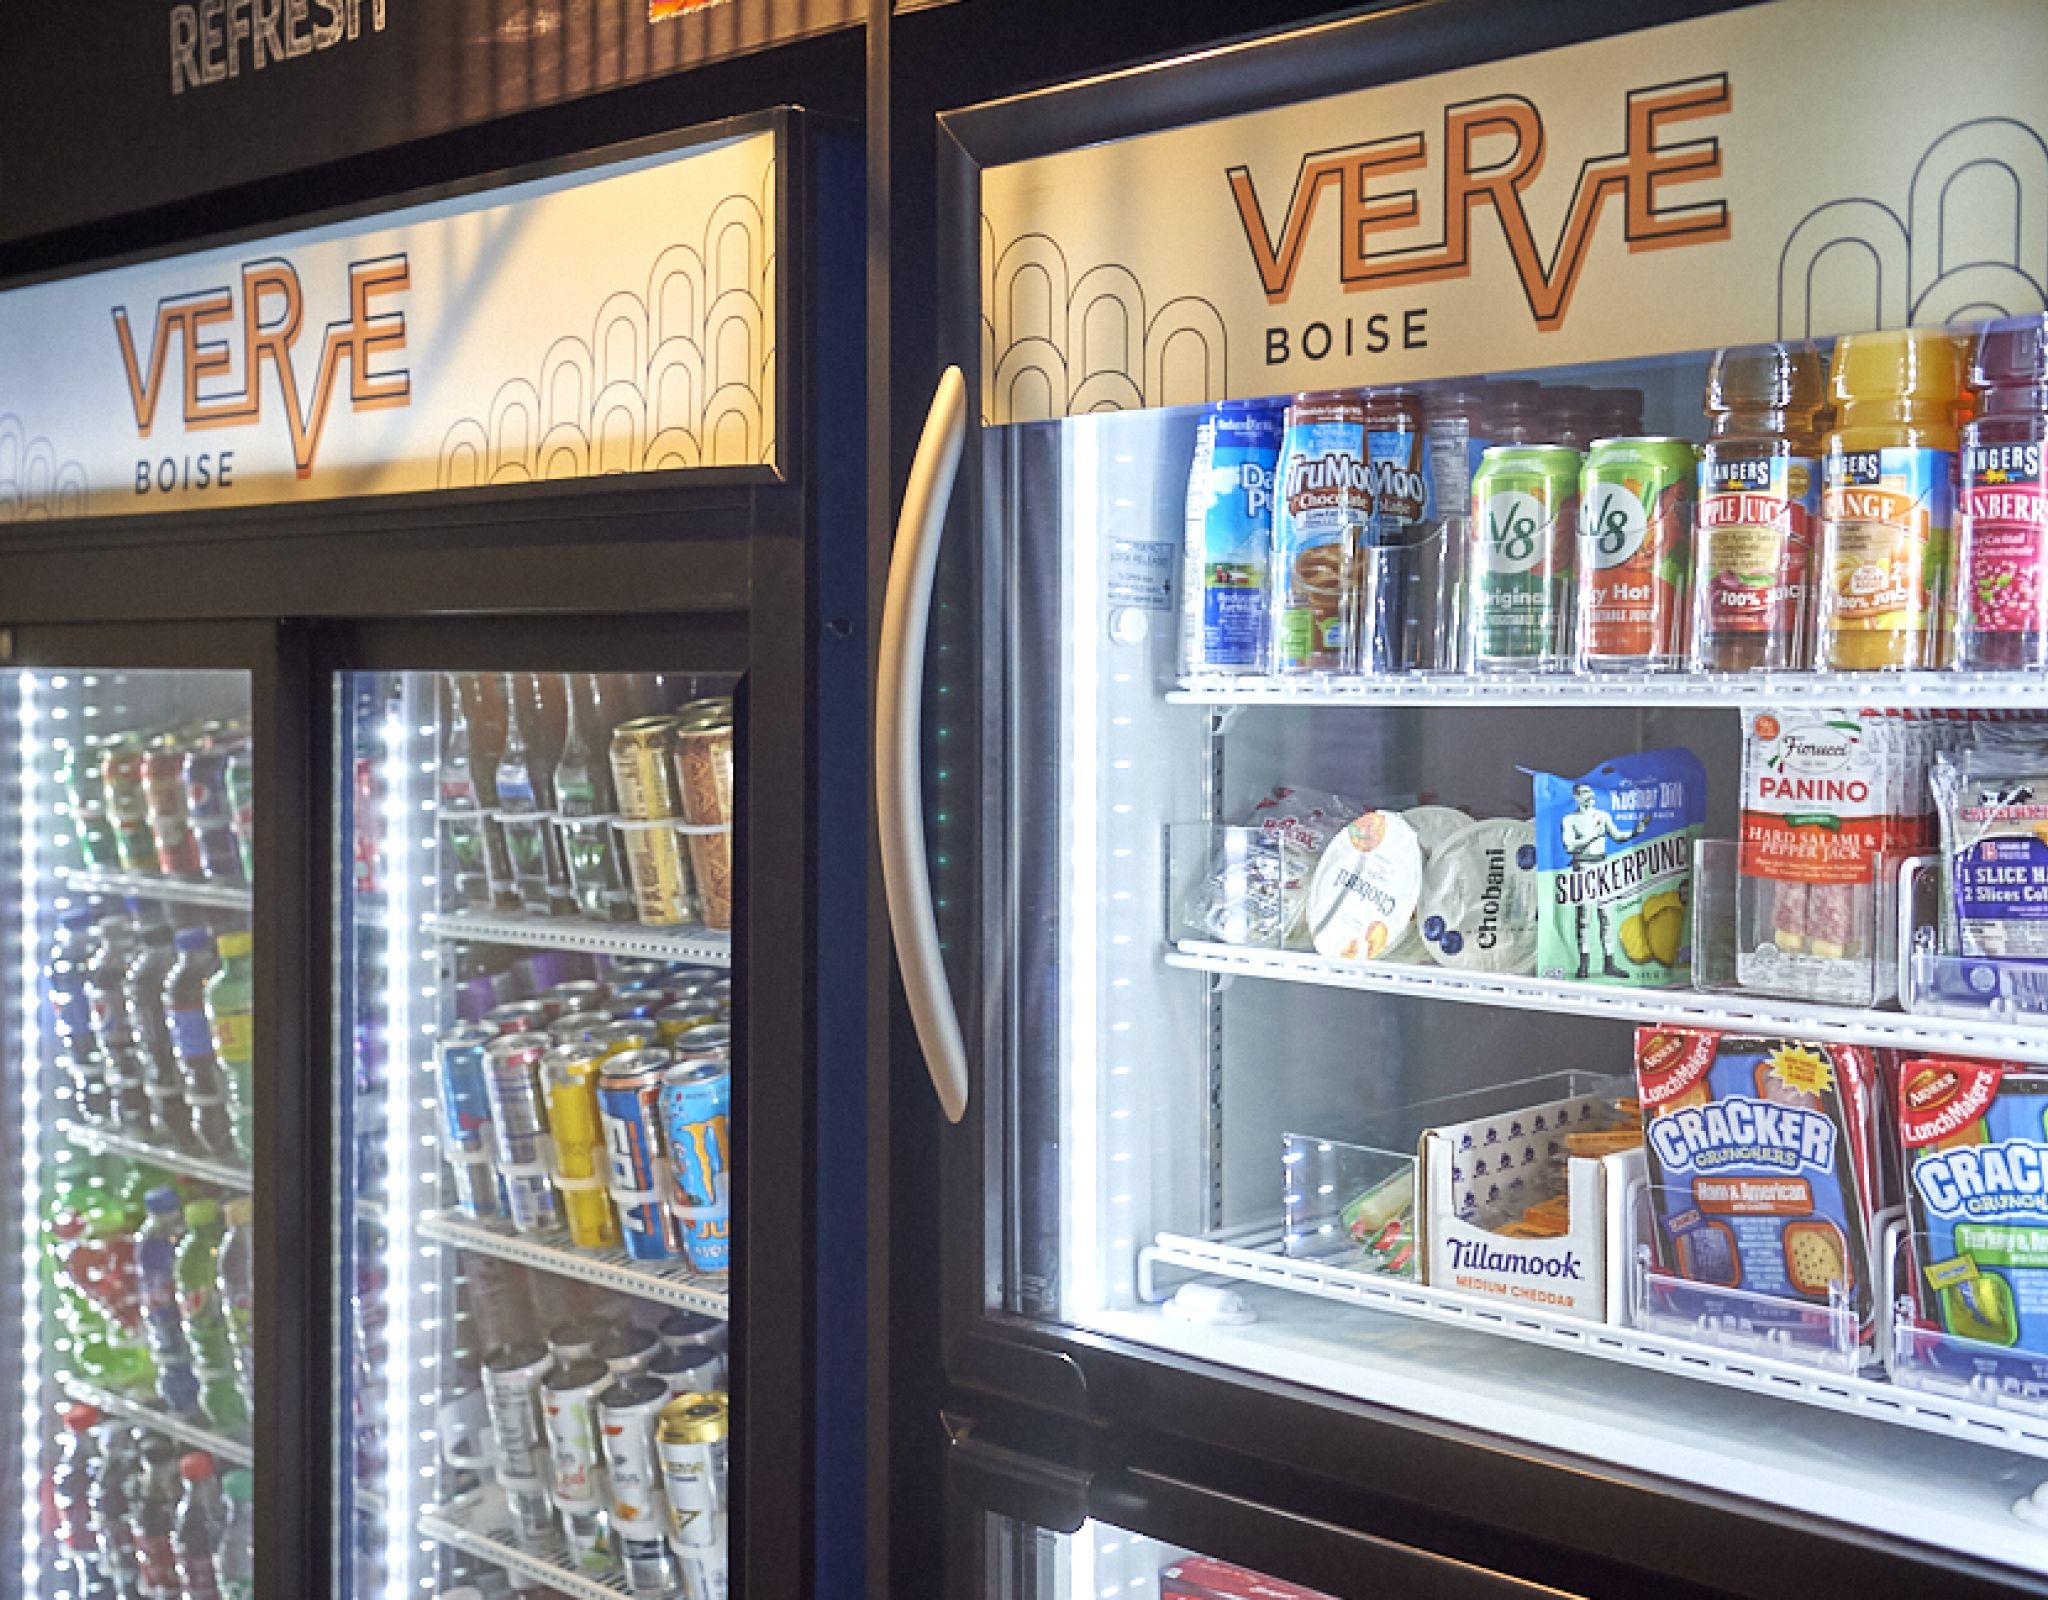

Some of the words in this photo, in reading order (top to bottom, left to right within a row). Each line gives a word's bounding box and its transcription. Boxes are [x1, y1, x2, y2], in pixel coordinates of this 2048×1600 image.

[1226, 71, 1733, 332] VERVE
[111, 252, 410, 479] VERVE
[1266, 308, 1428, 366] BOISE
[133, 450, 234, 495] BOISE
[1488, 500, 1536, 562] V8
[1585, 493, 1628, 558] V8
[1613, 583, 1651, 601] Hot
[1759, 776, 1869, 803] PANINO
[1478, 848, 1505, 949] Chobani
[1975, 866, 2028, 885] SLICE
[1652, 1099, 1834, 1171] CRACKER
[1446, 1237, 1582, 1280] Tillamook
[1455, 1274, 1507, 1296] MEDIUM
[1510, 1285, 1574, 1309] CHEDDAR
